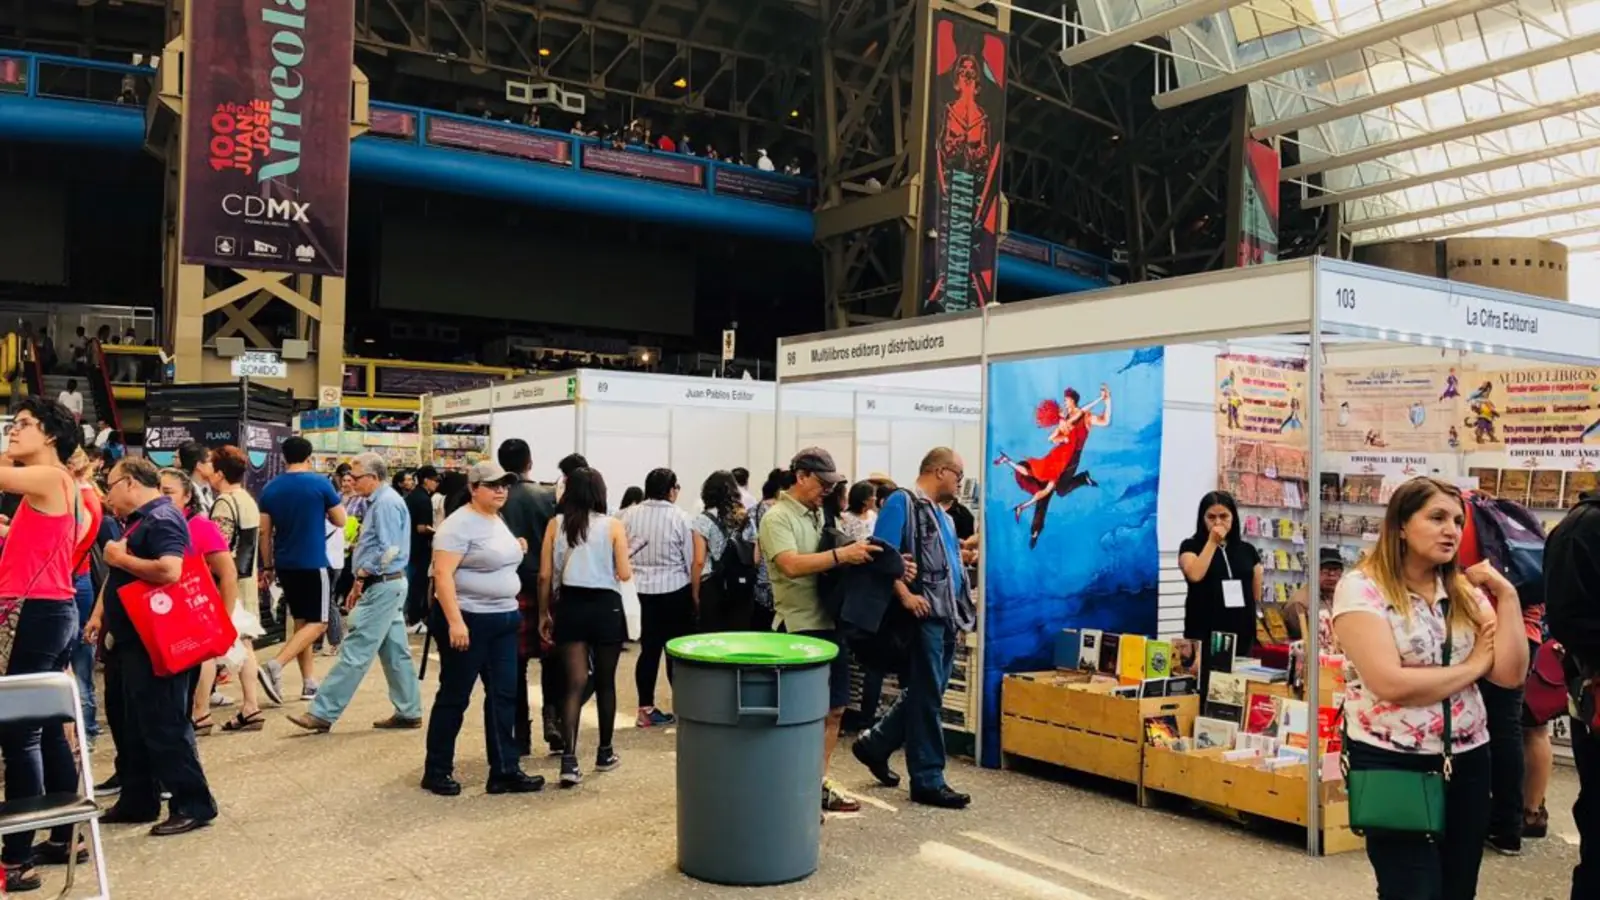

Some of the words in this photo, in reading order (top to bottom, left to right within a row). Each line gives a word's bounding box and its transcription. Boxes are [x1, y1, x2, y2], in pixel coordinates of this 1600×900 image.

[209, 113, 235, 171] 100
[249, 99, 271, 157] JOSÉ
[234, 114, 253, 176] JUAN
[221, 193, 311, 223] CDMX
[945, 168, 974, 313] RANKENSTEIN
[1336, 287, 1356, 309] 103
[1466, 305, 1477, 326] La
[1480, 309, 1502, 330] Cifra
[1503, 313, 1538, 333] Editorial
[810, 346, 850, 363] Multilibros
[851, 342, 880, 358] editora
[880, 344, 886, 359] y
[887, 334, 945, 355] distribuidora
[240, 364, 279, 375] SONIDO
[1497, 371, 1542, 384] AUDIO
[1543, 369, 1597, 382] LIBROS
[685, 389, 705, 399] Juan
[205, 431, 231, 440] PLANO
[1510, 449, 1556, 457] EDITORIAL
